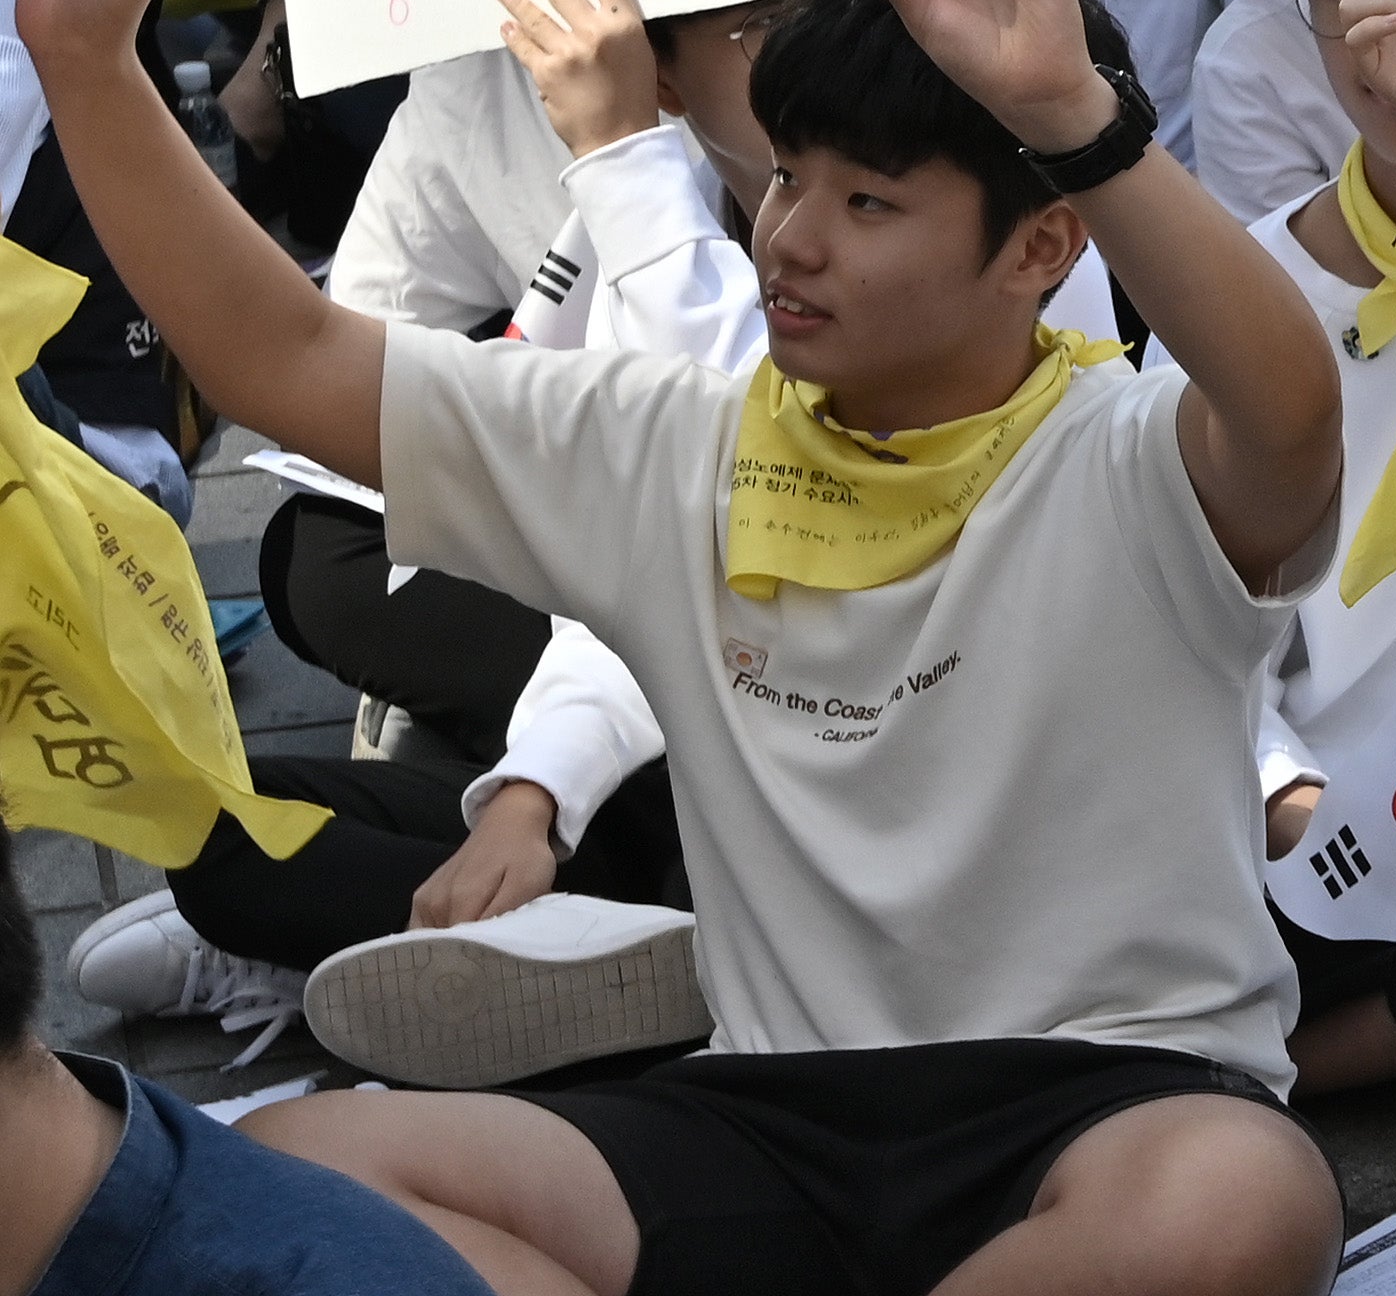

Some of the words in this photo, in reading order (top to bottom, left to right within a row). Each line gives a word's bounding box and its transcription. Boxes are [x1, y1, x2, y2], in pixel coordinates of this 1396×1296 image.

[732, 671, 781, 706] From
[786, 692, 818, 715] the
[824, 698, 884, 722] Coast
[907, 650, 962, 695] Valley.
